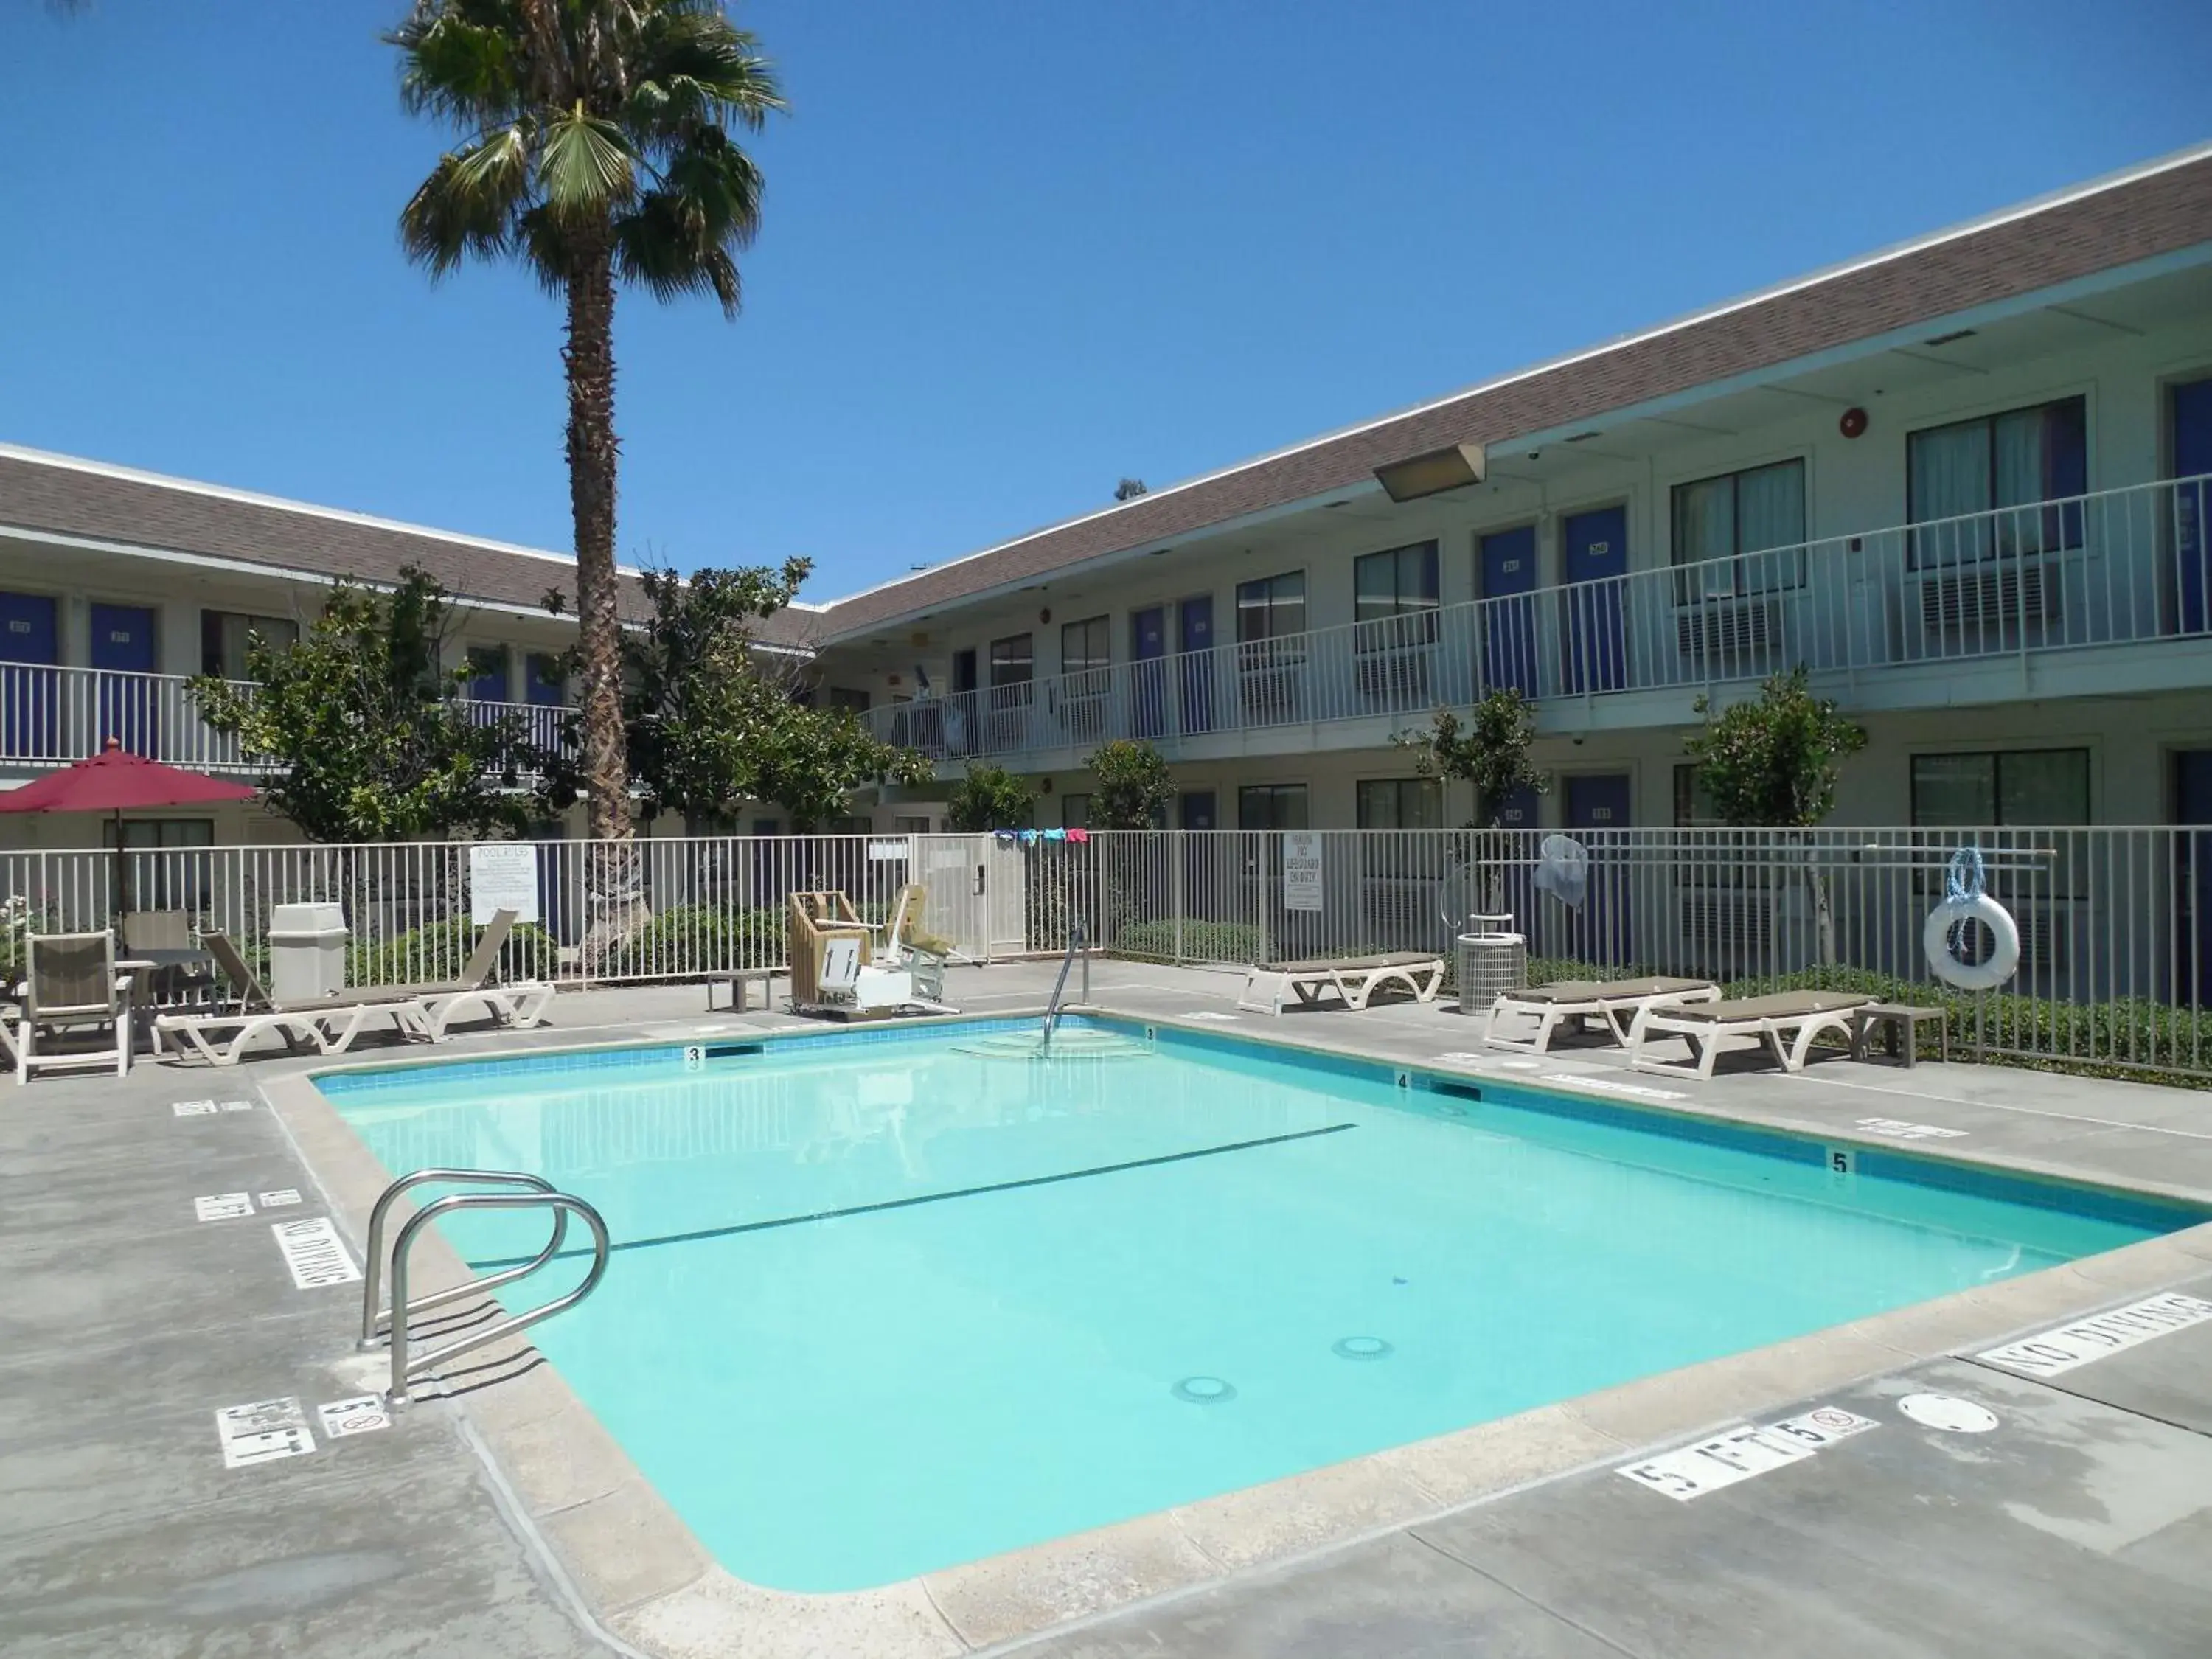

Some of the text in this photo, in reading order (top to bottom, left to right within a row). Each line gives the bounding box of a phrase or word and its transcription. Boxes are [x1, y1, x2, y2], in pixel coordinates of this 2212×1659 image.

[689, 1048, 700, 1061] 3
[1399, 1074, 1406, 1088] 4
[1833, 1152, 1847, 1173] 5
[282, 1218, 350, 1284] NO DIVING
[1991, 1295, 2212, 1369] NO DIVING
[1774, 1422, 1826, 1443] 5
[1630, 1432, 1795, 1493] 5 FT
